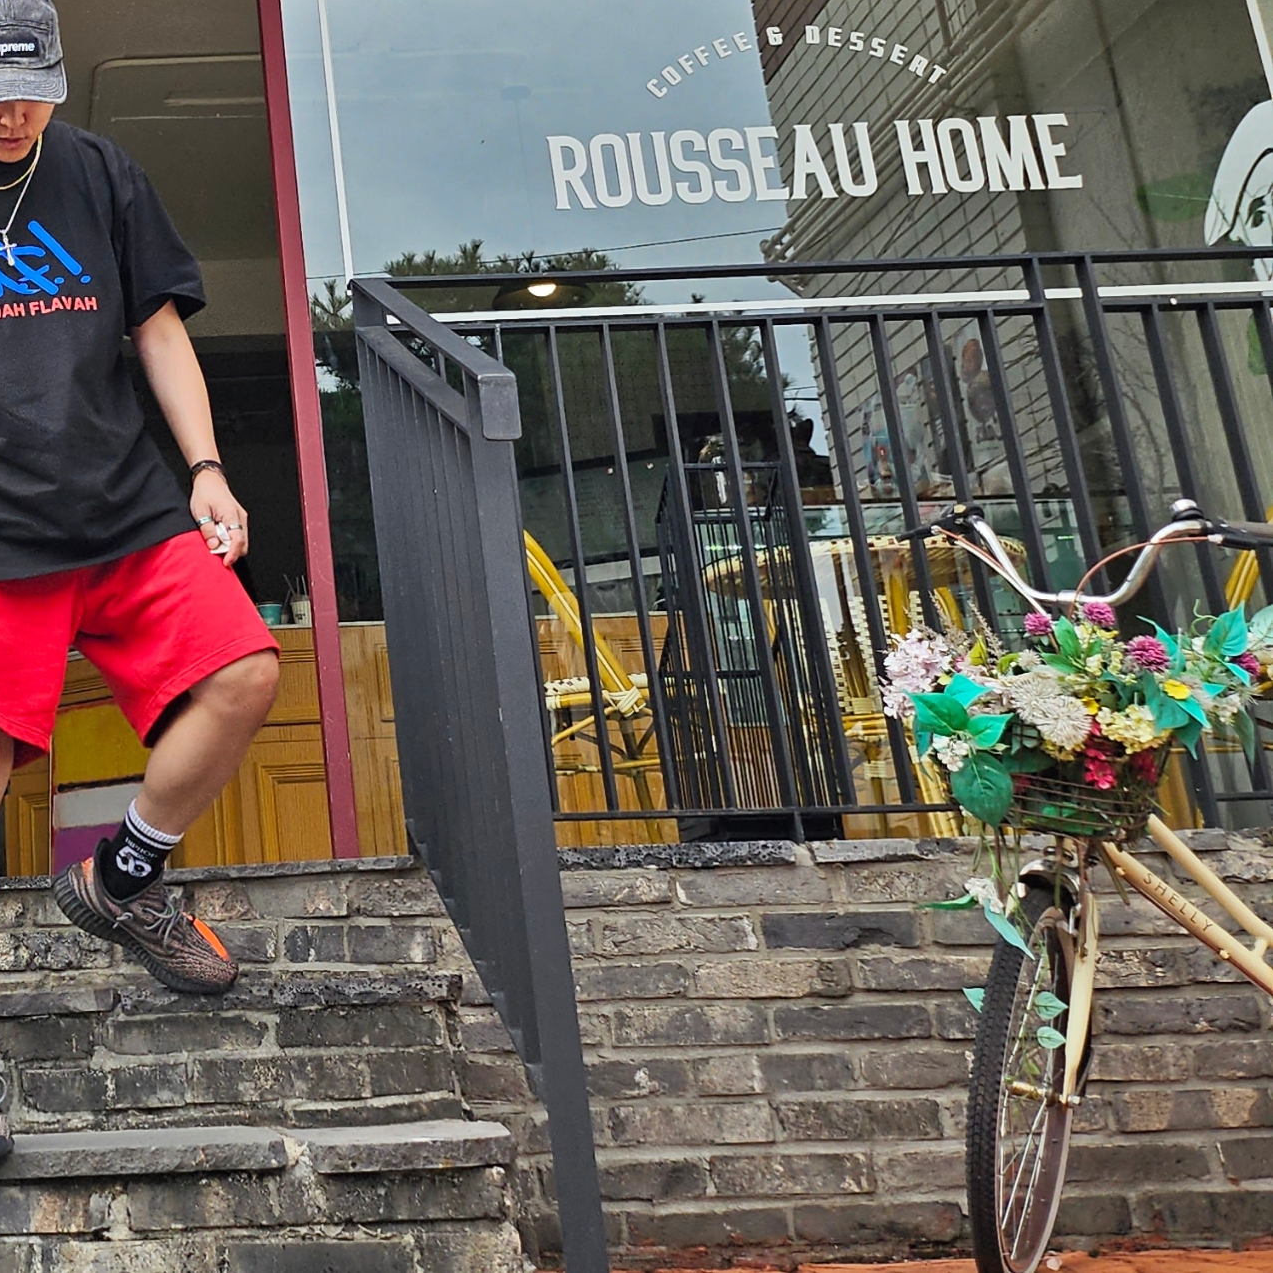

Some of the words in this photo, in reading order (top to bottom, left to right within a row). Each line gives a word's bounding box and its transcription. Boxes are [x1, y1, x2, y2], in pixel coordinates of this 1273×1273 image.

[645, 30, 753, 99] COFFEE
[764, 25, 784, 46] &
[804, 24, 948, 85] DESSERT
[545, 121, 879, 211] ROUSSEAU
[892, 112, 1084, 197] HOME
[28, 295, 98, 317] FLAVAH
[1143, 872, 1214, 932] SHELLY
